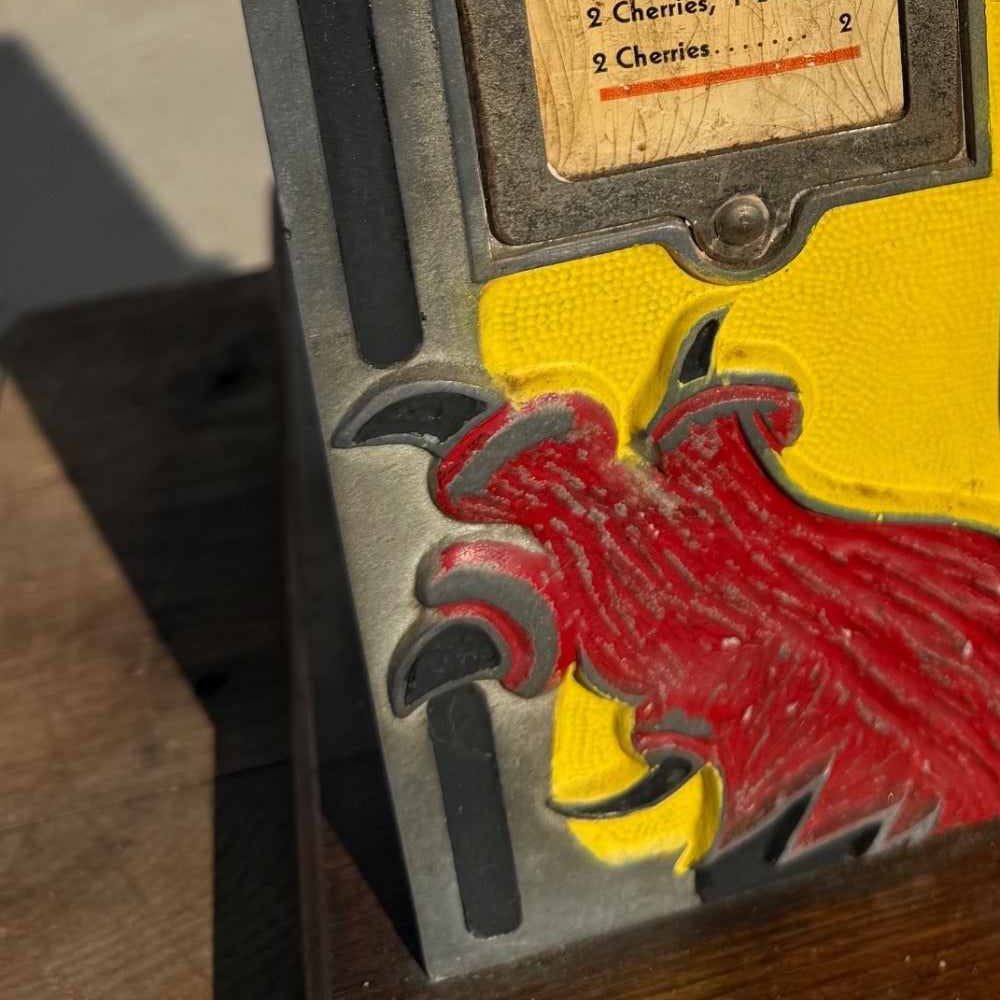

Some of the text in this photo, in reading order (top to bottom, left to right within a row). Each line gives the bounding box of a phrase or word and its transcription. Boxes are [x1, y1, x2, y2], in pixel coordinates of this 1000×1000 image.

[587, 6, 602, 28] 2
[593, 14, 852, 74] 2 Cherries 2
